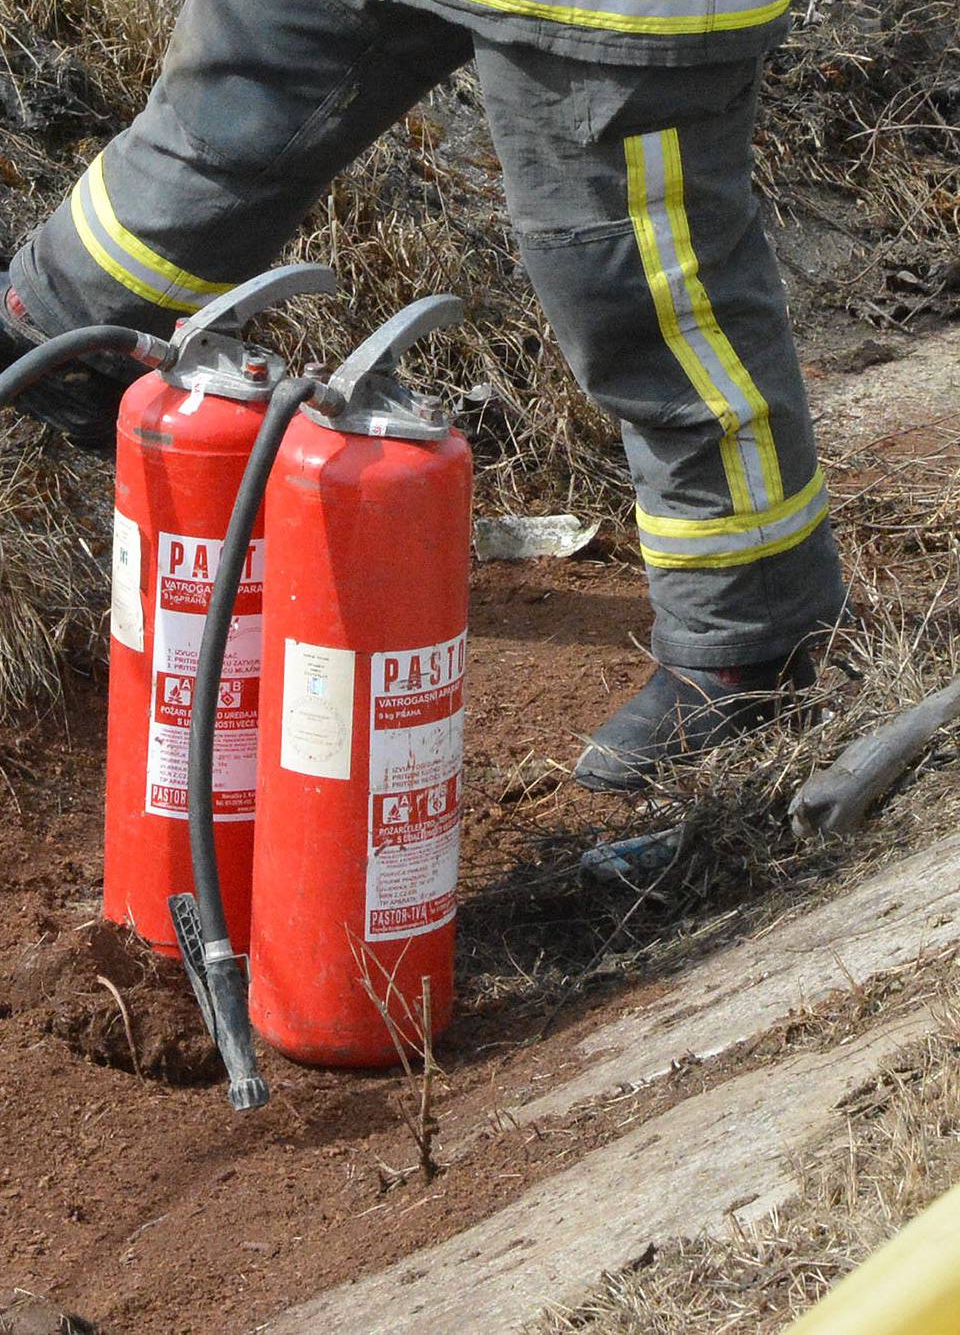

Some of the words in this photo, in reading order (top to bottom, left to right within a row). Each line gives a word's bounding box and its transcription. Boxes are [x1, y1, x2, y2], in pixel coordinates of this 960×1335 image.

[170, 541, 256, 579] PAT
[164, 579, 214, 595] VATROGA
[181, 679, 191, 690] A
[232, 680, 242, 692] B
[378, 691, 438, 708] VATROGASNI
[152, 784, 187, 805] PASTOR
[400, 795, 409, 807] A
